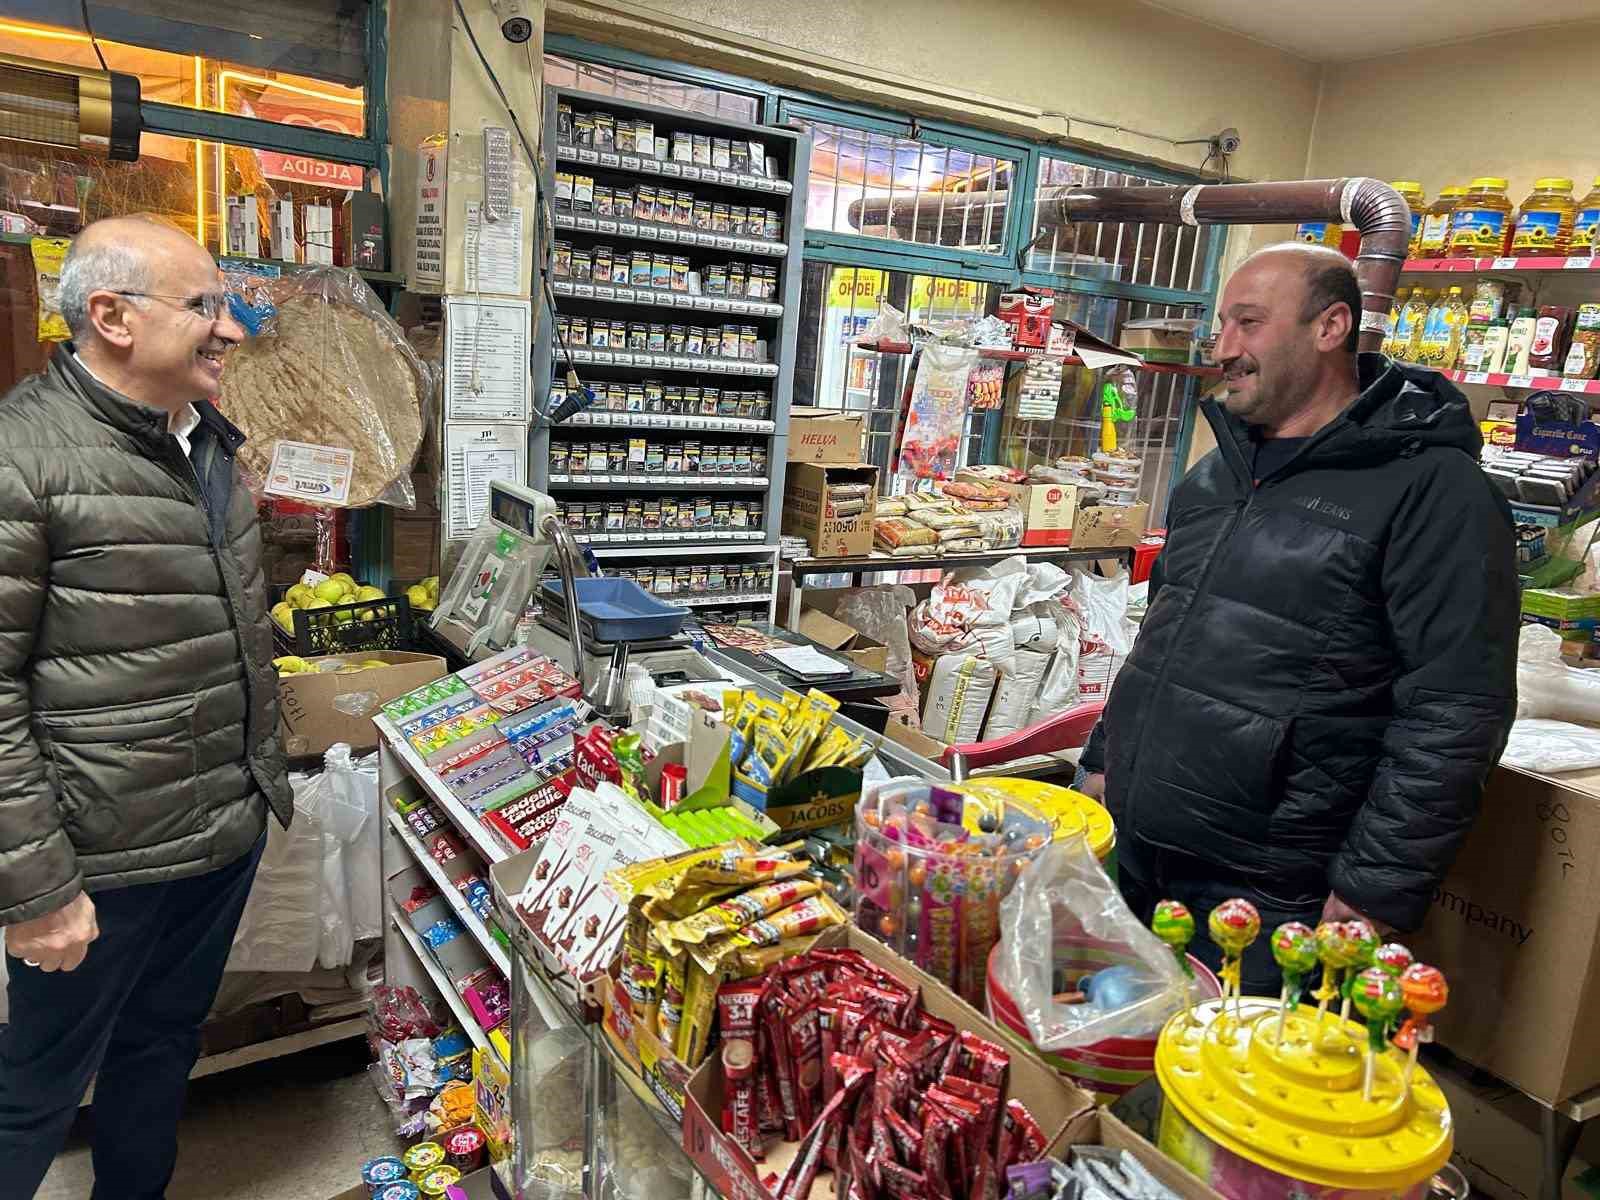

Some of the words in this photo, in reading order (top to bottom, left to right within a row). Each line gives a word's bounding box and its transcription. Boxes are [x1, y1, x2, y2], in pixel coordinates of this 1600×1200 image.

[856, 282, 875, 297] DE!
[800, 433, 838, 446] HELVA
[1514, 512, 1537, 524] tos
[507, 790, 563, 824] tadelle
[790, 801, 846, 825] JACOBS
